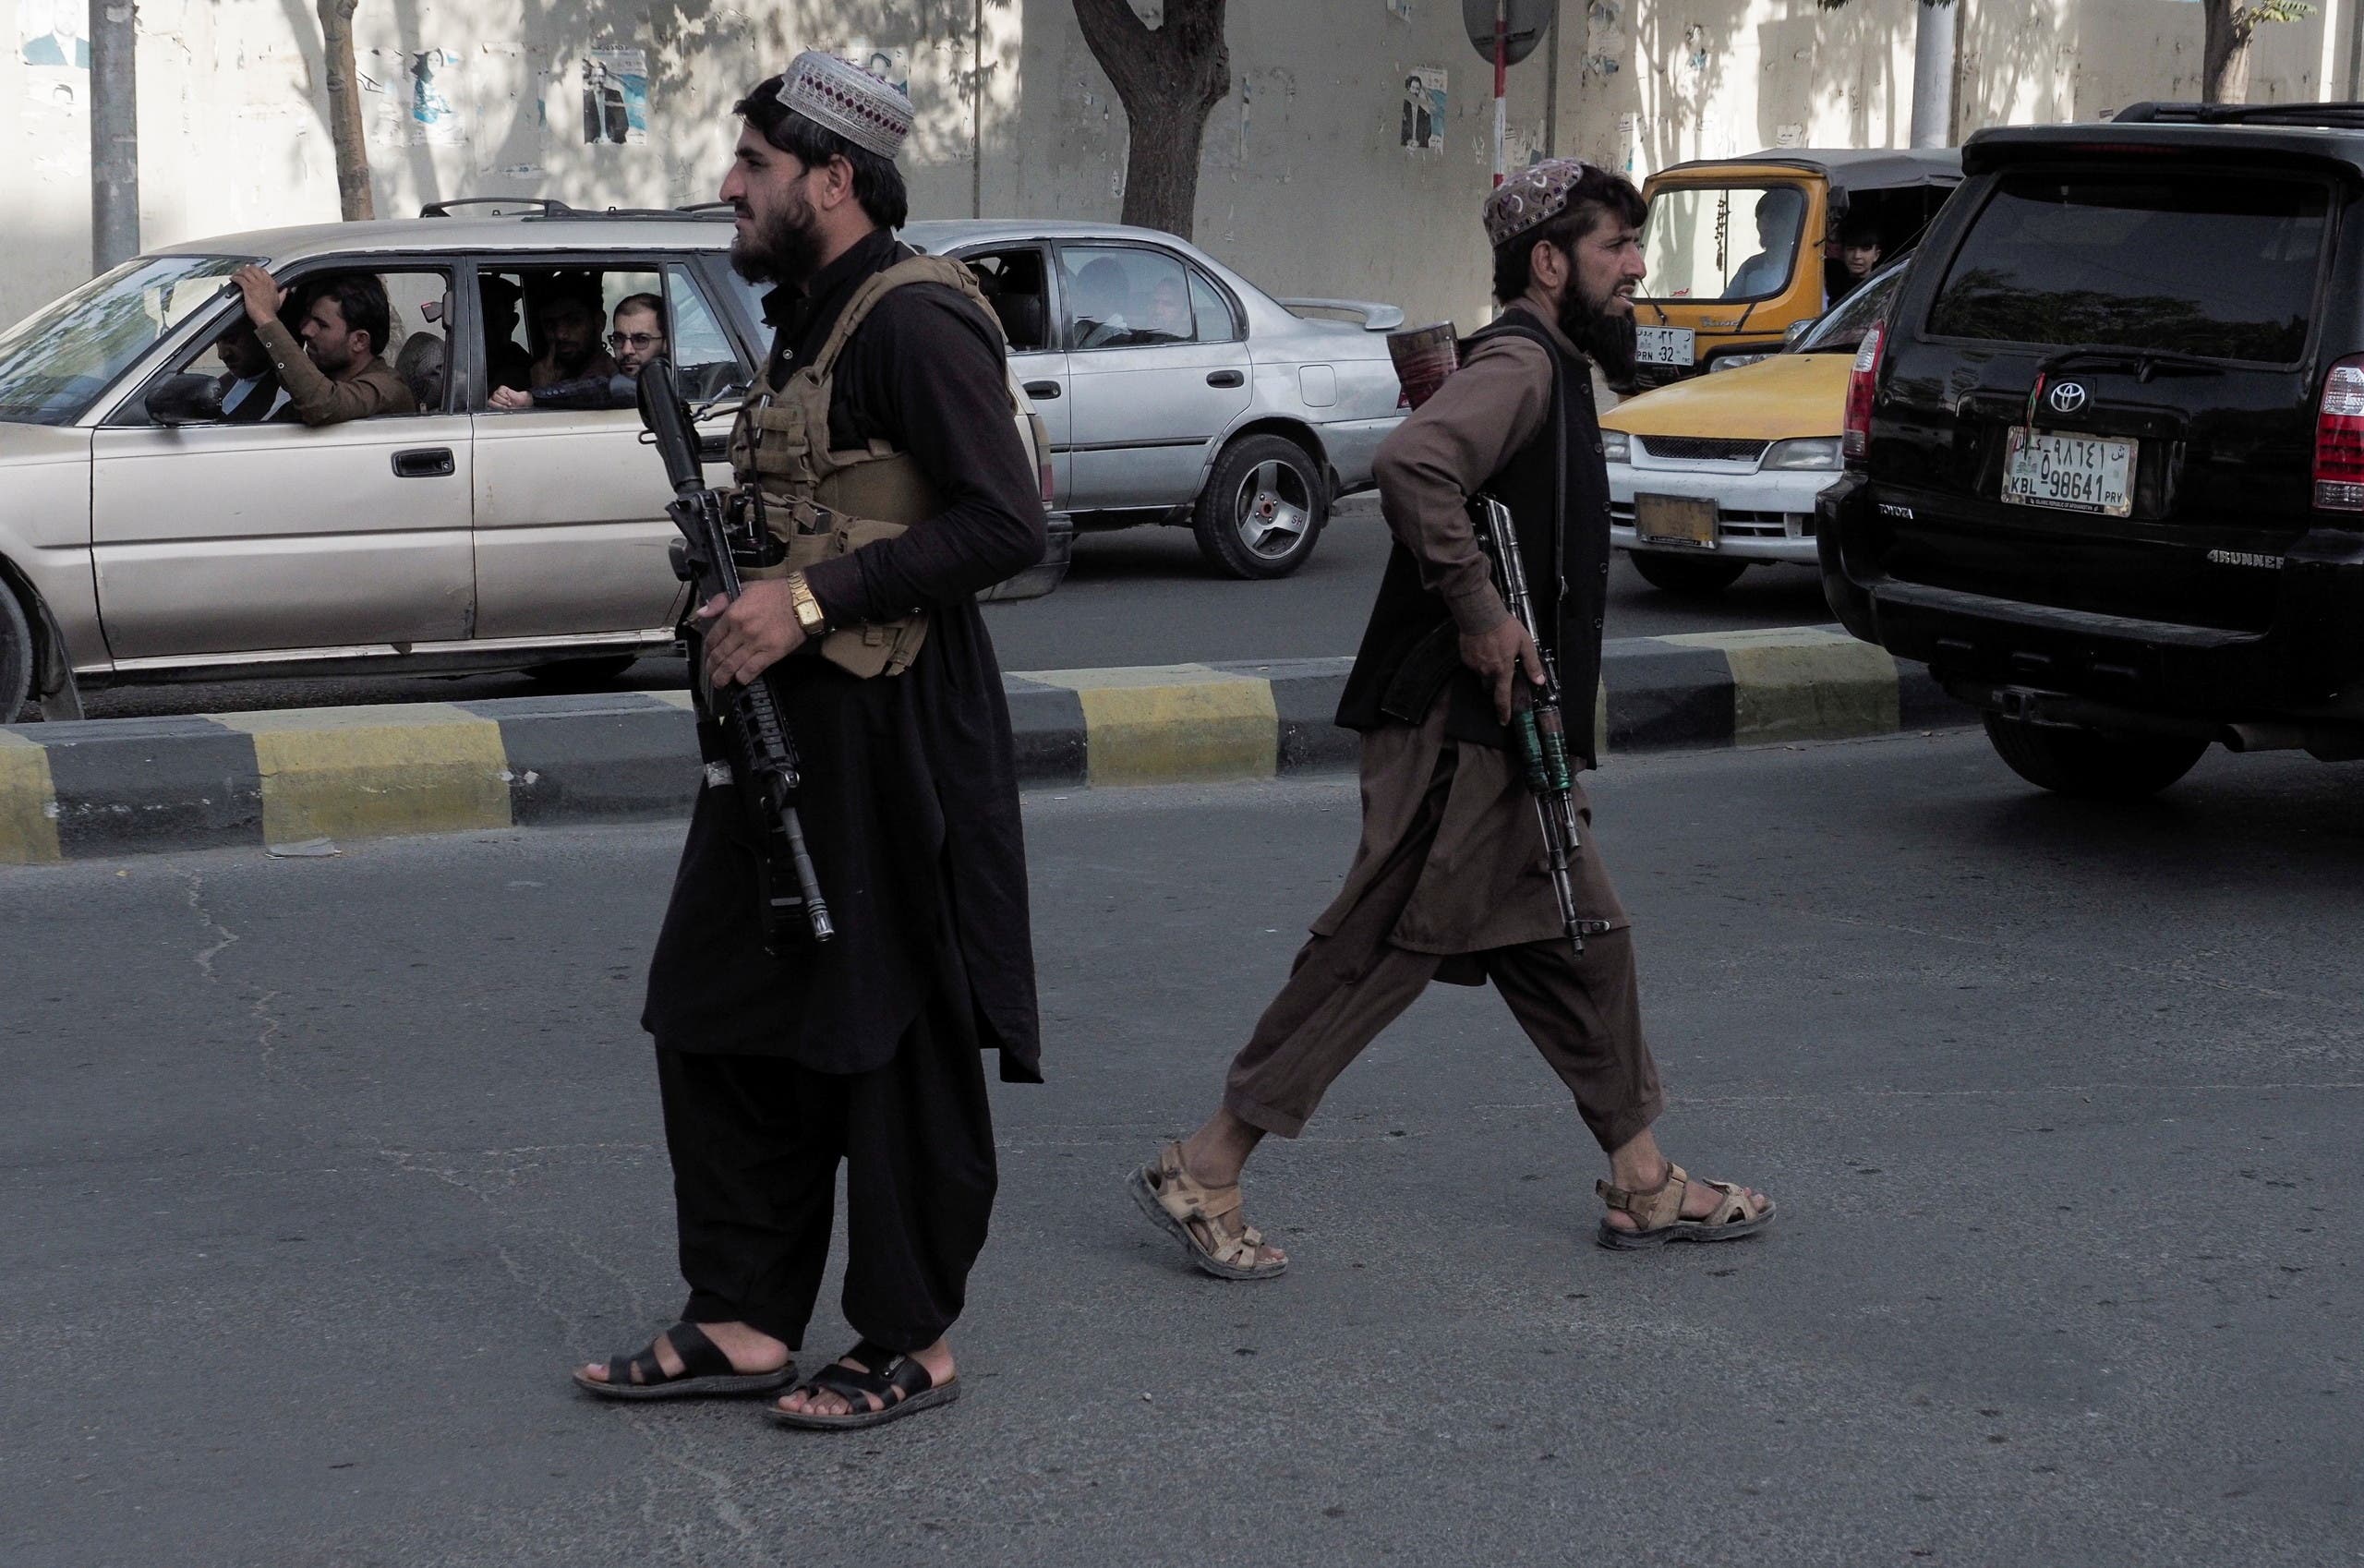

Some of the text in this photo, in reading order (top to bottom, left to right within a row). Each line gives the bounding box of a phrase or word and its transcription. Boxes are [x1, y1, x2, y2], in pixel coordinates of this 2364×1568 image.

[1636, 350, 1653, 361] PRN
[1661, 346, 1674, 362] 32
[2054, 439, 2105, 470] ٩٨٦٤١
[2010, 476, 2037, 495] KBL
[2049, 470, 2104, 502] 98641
